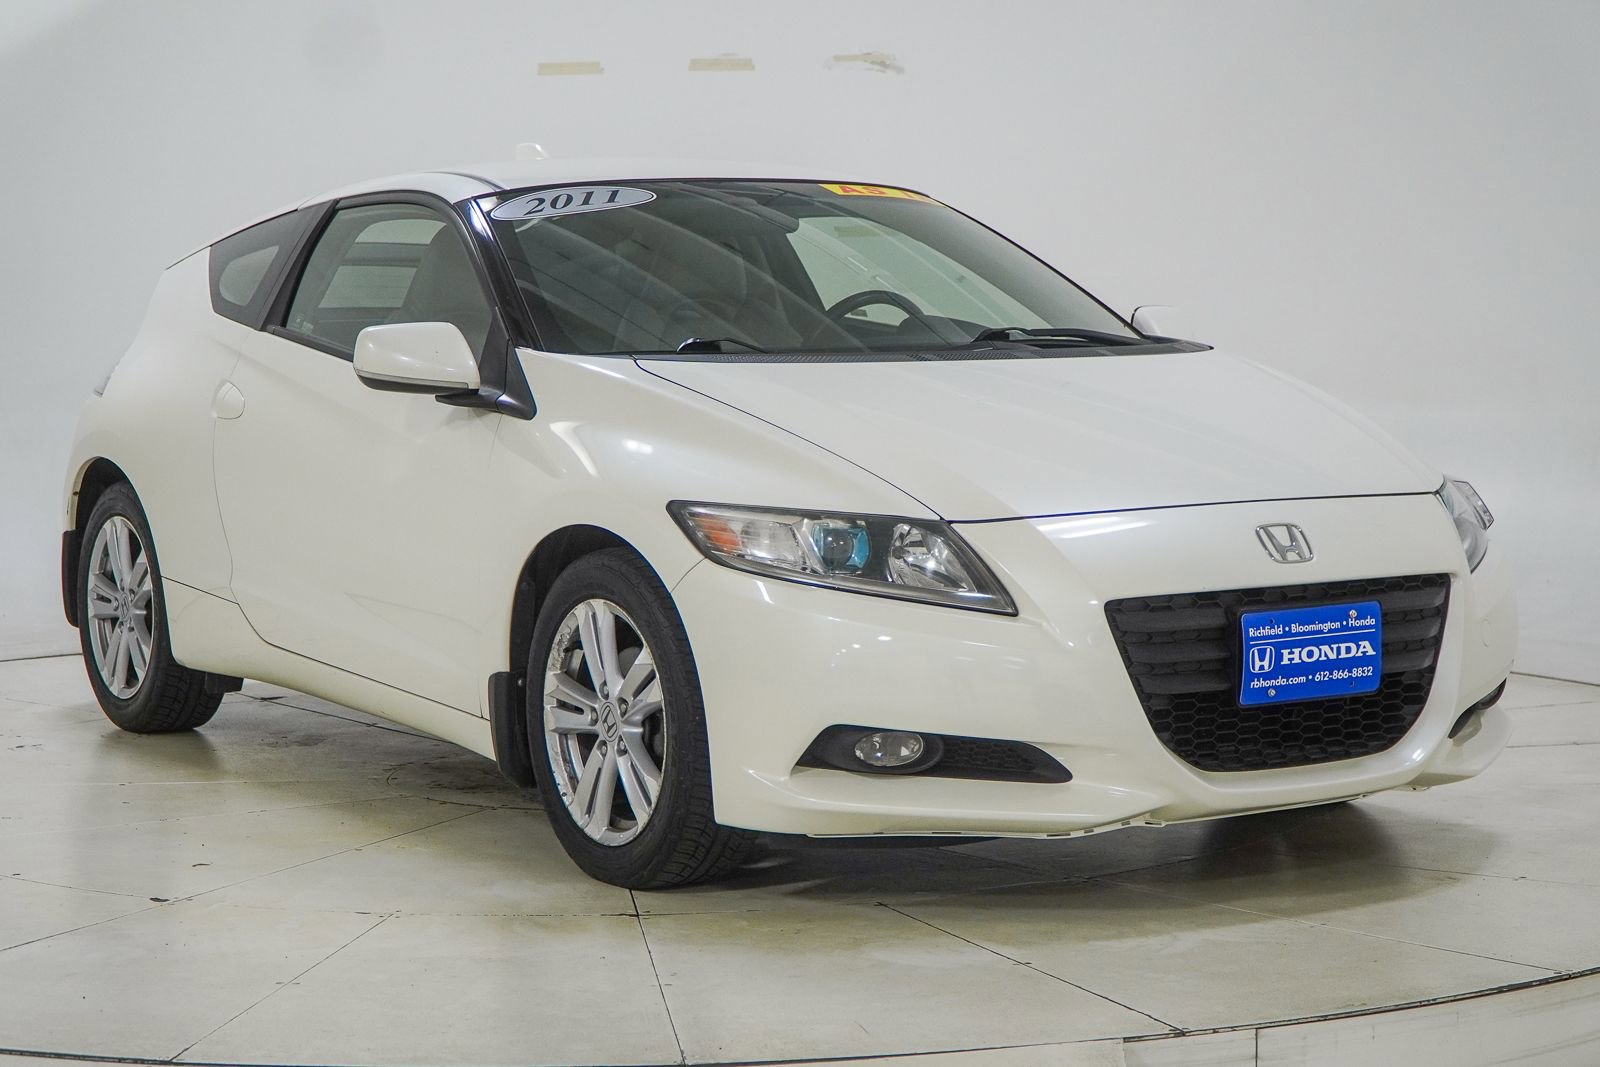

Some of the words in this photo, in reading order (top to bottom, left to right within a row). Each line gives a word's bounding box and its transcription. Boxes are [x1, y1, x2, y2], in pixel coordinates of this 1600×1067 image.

[523, 189, 621, 217] 2011
[1248, 624, 1283, 638] Richfield
[1291, 620, 1341, 634] Bloomington
[1348, 615, 1376, 628] Honda
[1280, 640, 1377, 665] HONDA
[1250, 675, 1307, 689] rbhonda.com
[1314, 665, 1373, 682] 612-866-8832
